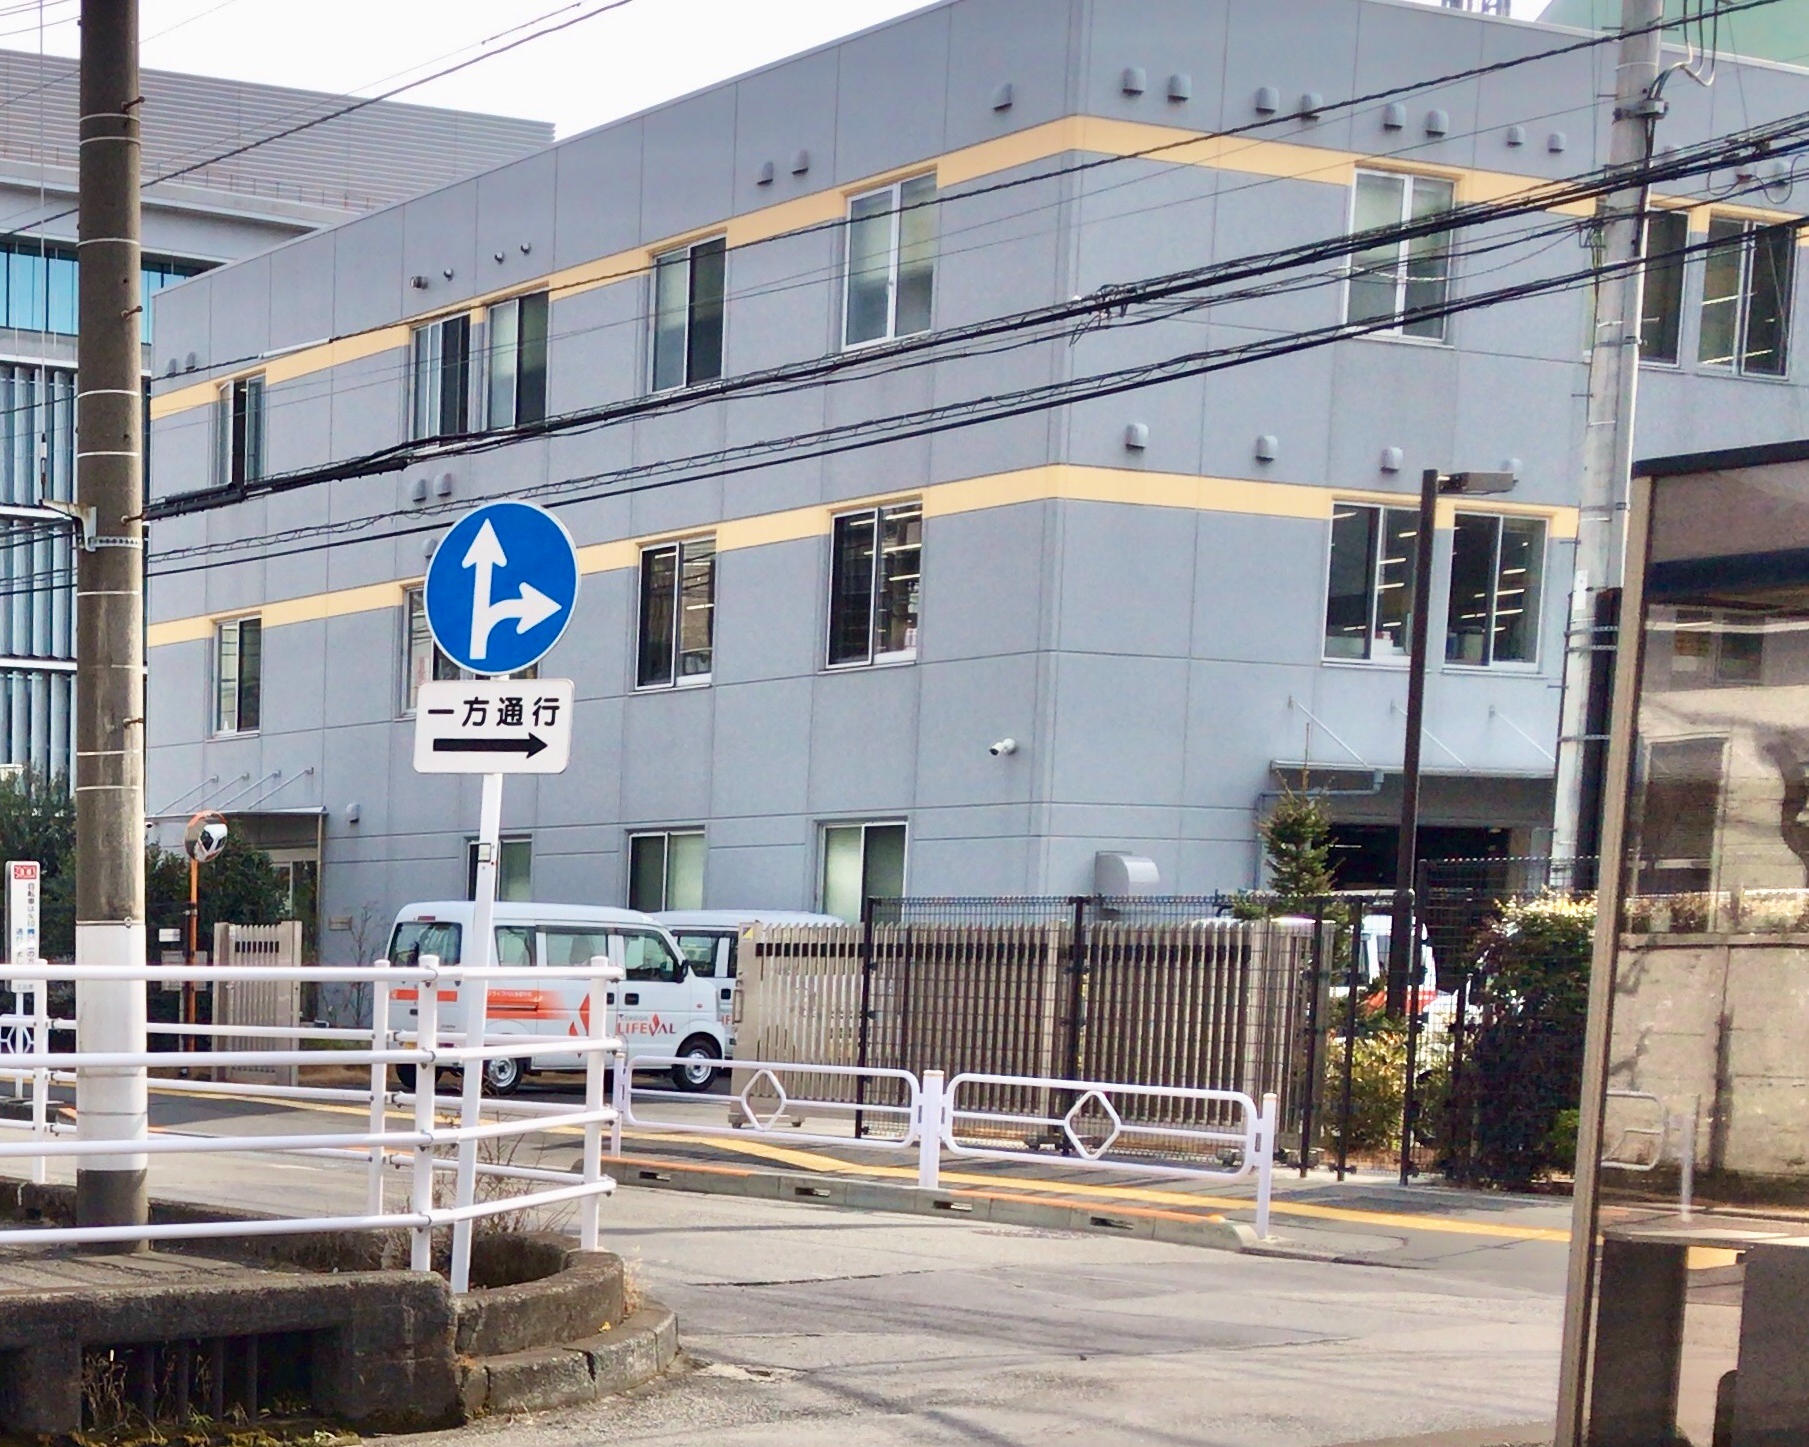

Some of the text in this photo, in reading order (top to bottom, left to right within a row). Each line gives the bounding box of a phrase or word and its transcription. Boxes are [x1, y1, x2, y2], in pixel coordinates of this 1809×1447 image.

[427, 696, 561, 727] 一方通行
[616, 1018, 677, 1036] LIFEVAL
